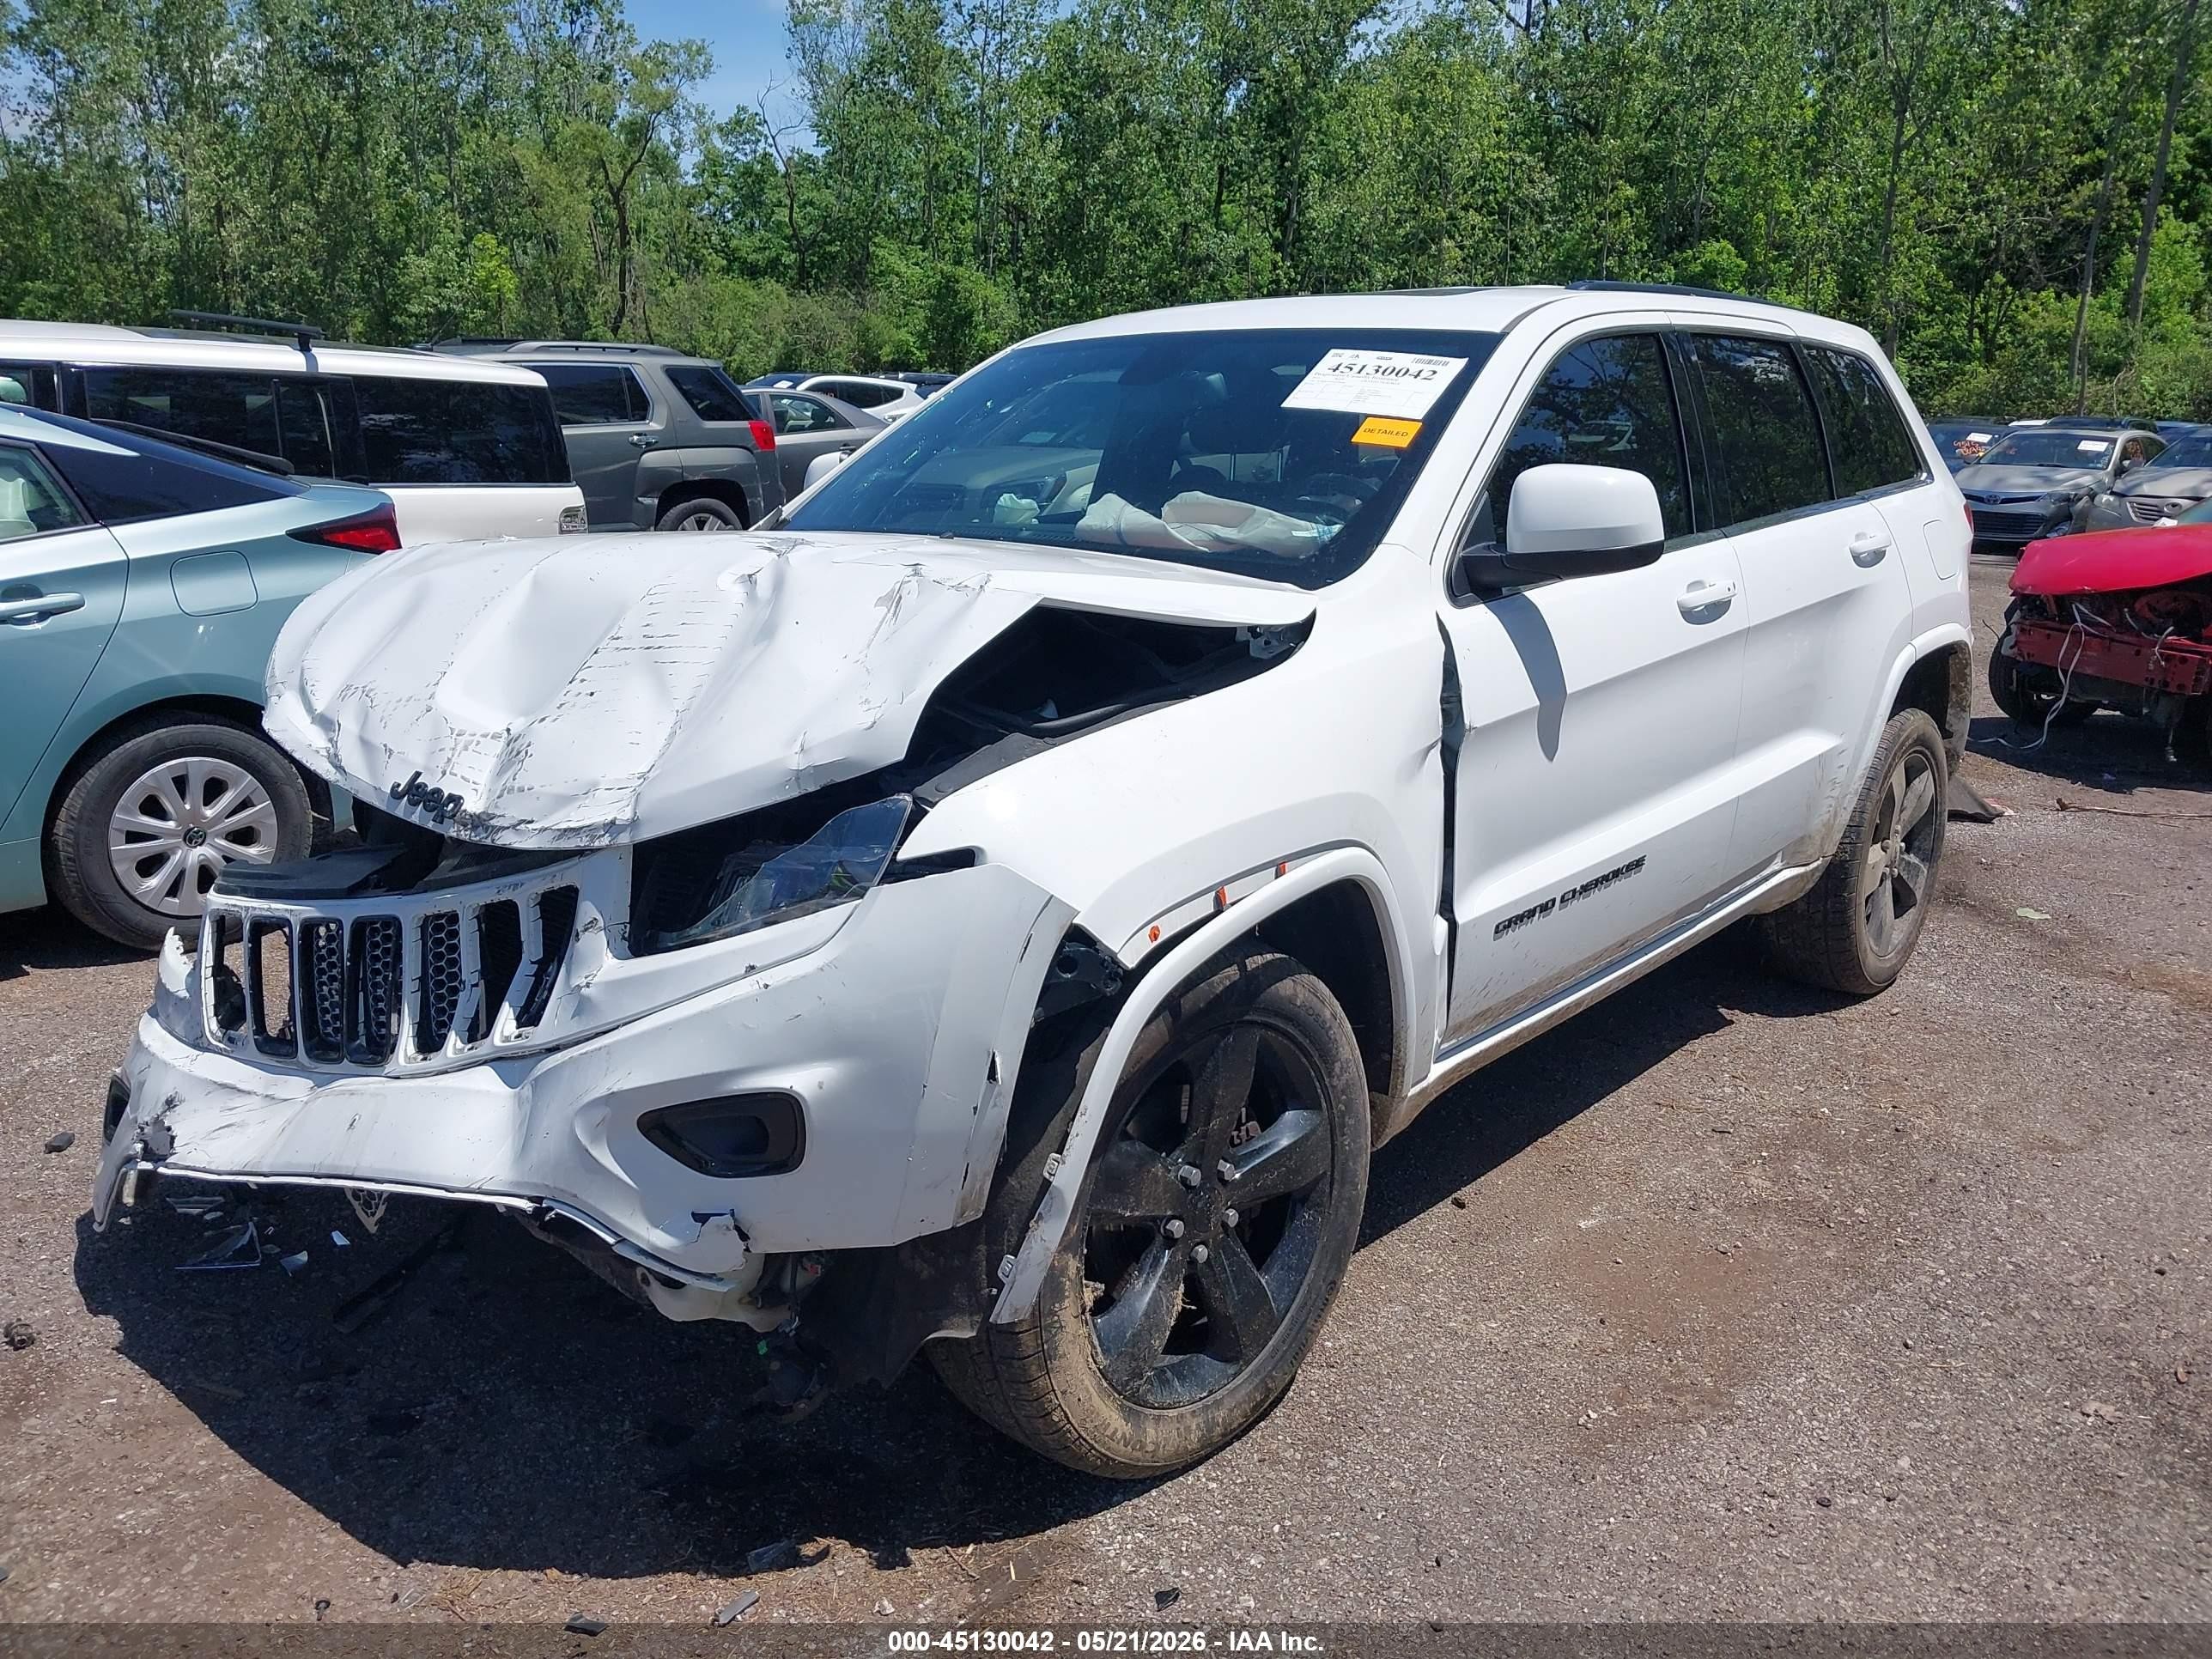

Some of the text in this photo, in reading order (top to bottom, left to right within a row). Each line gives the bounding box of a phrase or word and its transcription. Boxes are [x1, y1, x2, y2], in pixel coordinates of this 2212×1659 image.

[1328, 362, 1437, 380] 45130042
[1363, 428, 1408, 437] DETAILED
[390, 770, 465, 824] Jeep
[1494, 854, 1647, 935] GRAND CHEROKEE
